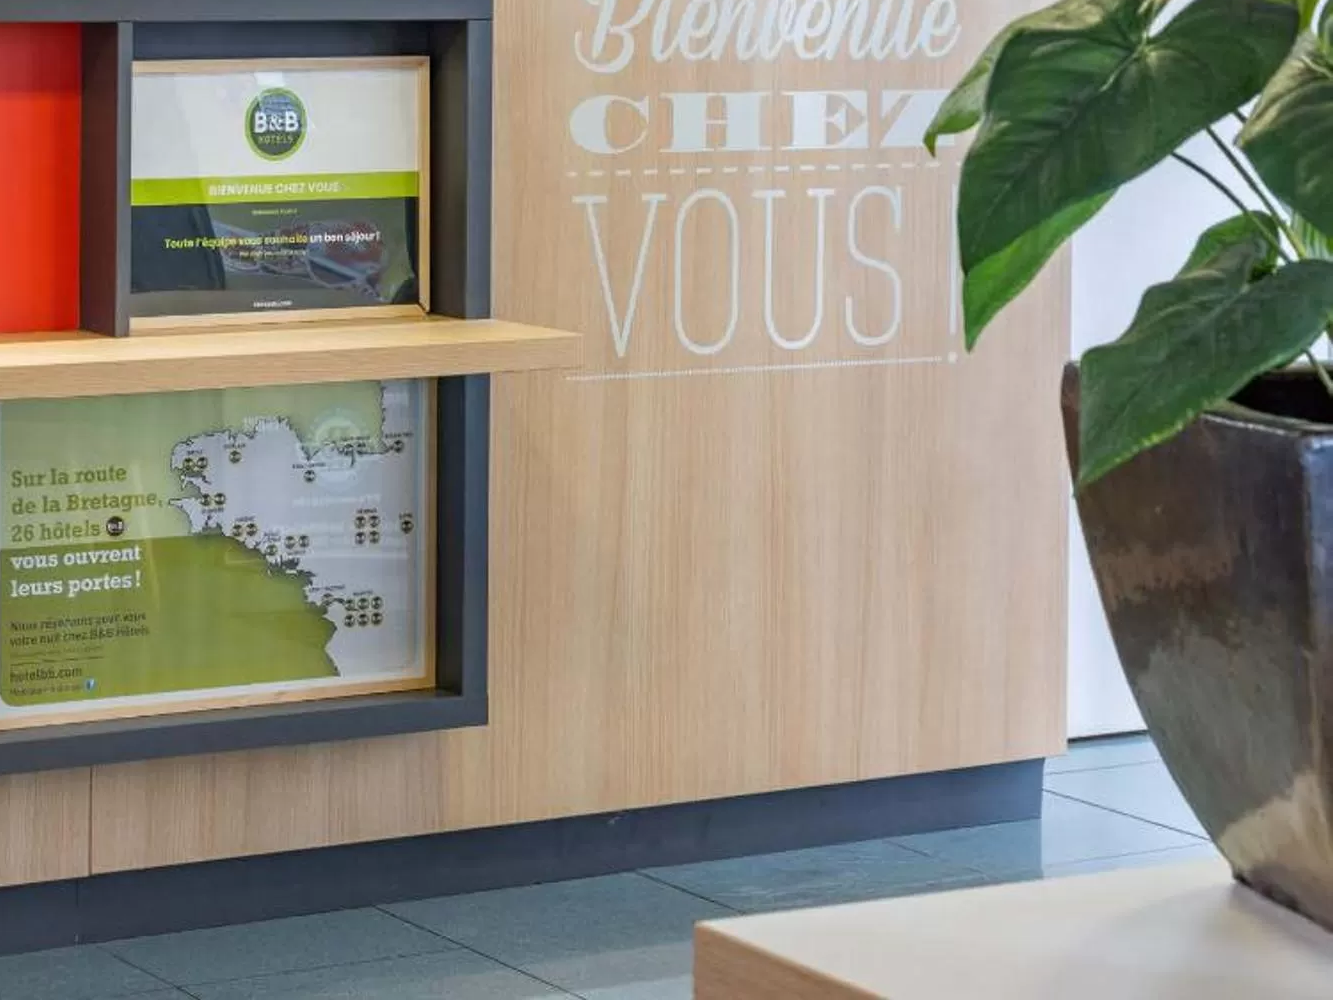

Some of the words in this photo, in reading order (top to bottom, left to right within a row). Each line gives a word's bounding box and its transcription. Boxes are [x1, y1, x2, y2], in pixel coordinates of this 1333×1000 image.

[254, 110, 300, 134] B&B
[570, 89, 956, 154] CHEZ
[209, 183, 272, 196] BIENVENUE
[273, 182, 306, 195] CHEZ
[308, 181, 339, 193] VOUS
[165, 238, 194, 249] Toute
[239, 237, 263, 247] vous
[310, 233, 323, 243] un
[324, 232, 344, 243] bon
[11, 470, 45, 488] Sur
[50, 467, 70, 486] la
[75, 465, 127, 484] route
[12, 496, 36, 516] de
[42, 495, 61, 514] la
[12, 523, 35, 542] 26
[40, 519, 101, 542] hôtels
[10, 552, 58, 570] vous
[63, 545, 142, 566] ouvrent
[11, 578, 63, 598] leurs
